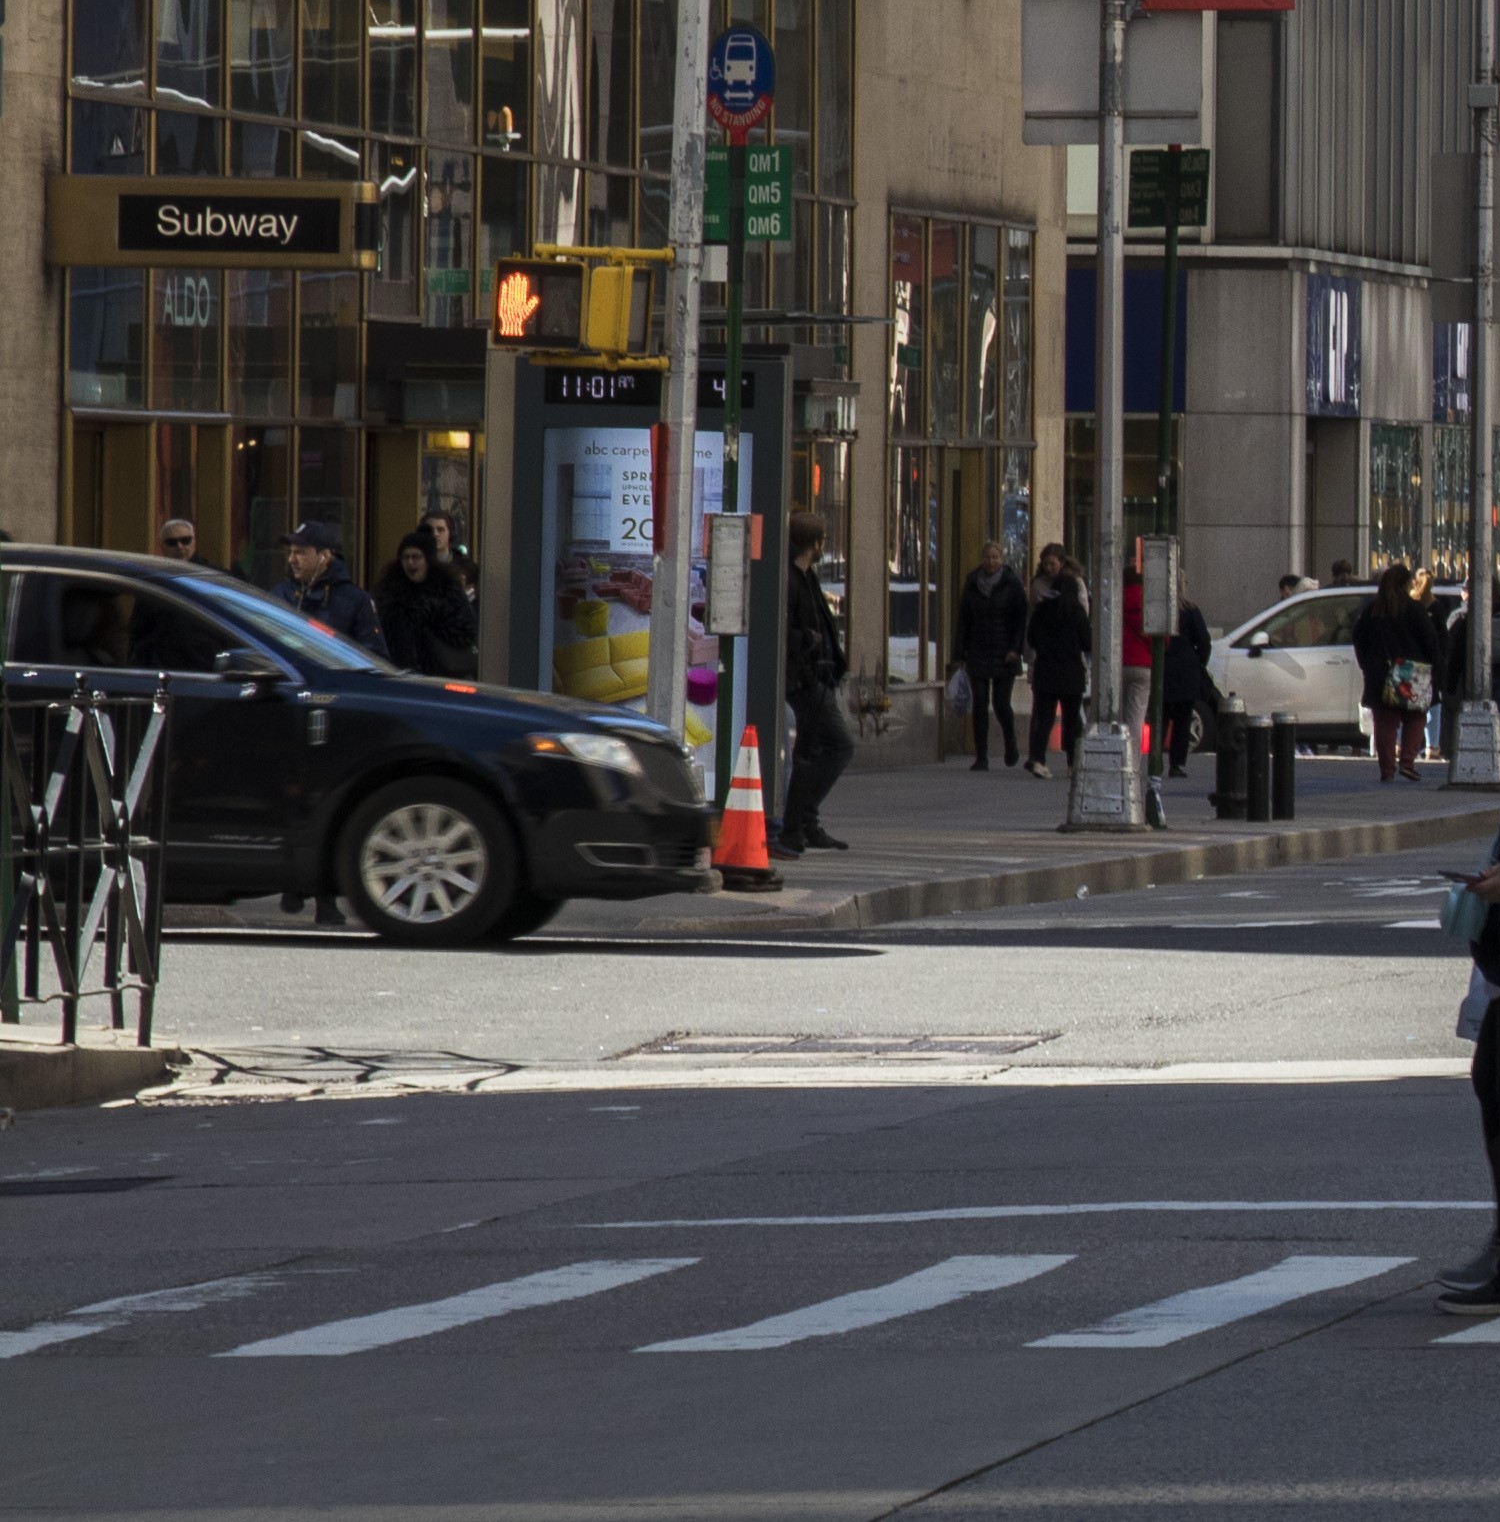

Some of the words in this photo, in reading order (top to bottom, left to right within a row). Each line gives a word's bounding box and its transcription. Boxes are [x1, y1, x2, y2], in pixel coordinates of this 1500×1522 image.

[721, 100, 766, 127] STANDING
[750, 150, 779, 172] QM1
[749, 182, 780, 204] QM5
[157, 205, 298, 244] Subway
[748, 213, 780, 236] QM6
[163, 276, 210, 327] ALDO
[563, 376, 614, 398] 11:01
[584, 440, 608, 455] abc
[612, 444, 650, 459] carpe
[622, 494, 651, 506] EVE
